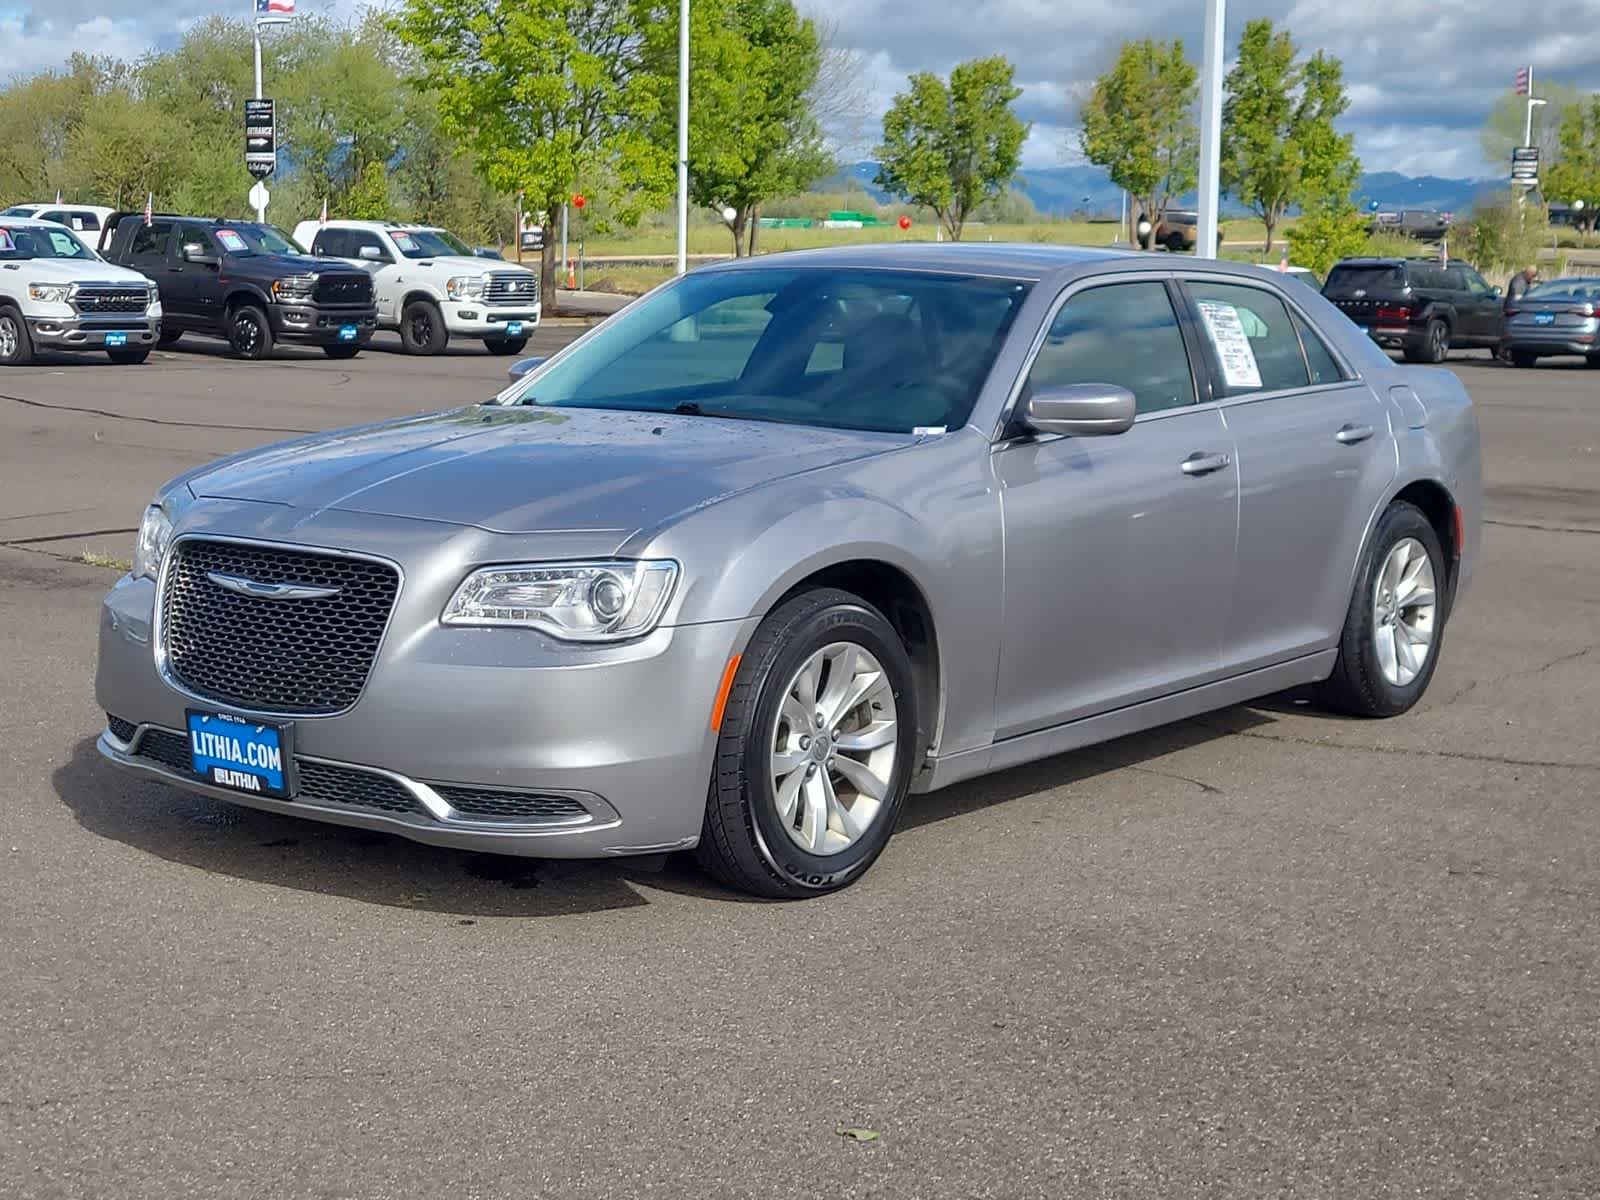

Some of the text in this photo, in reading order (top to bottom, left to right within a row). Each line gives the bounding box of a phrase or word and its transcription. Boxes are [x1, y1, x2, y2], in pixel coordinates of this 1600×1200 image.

[192, 730, 282, 772] LITHIA.COM
[225, 769, 261, 791] LITHIA
[784, 863, 836, 887] TOYO
